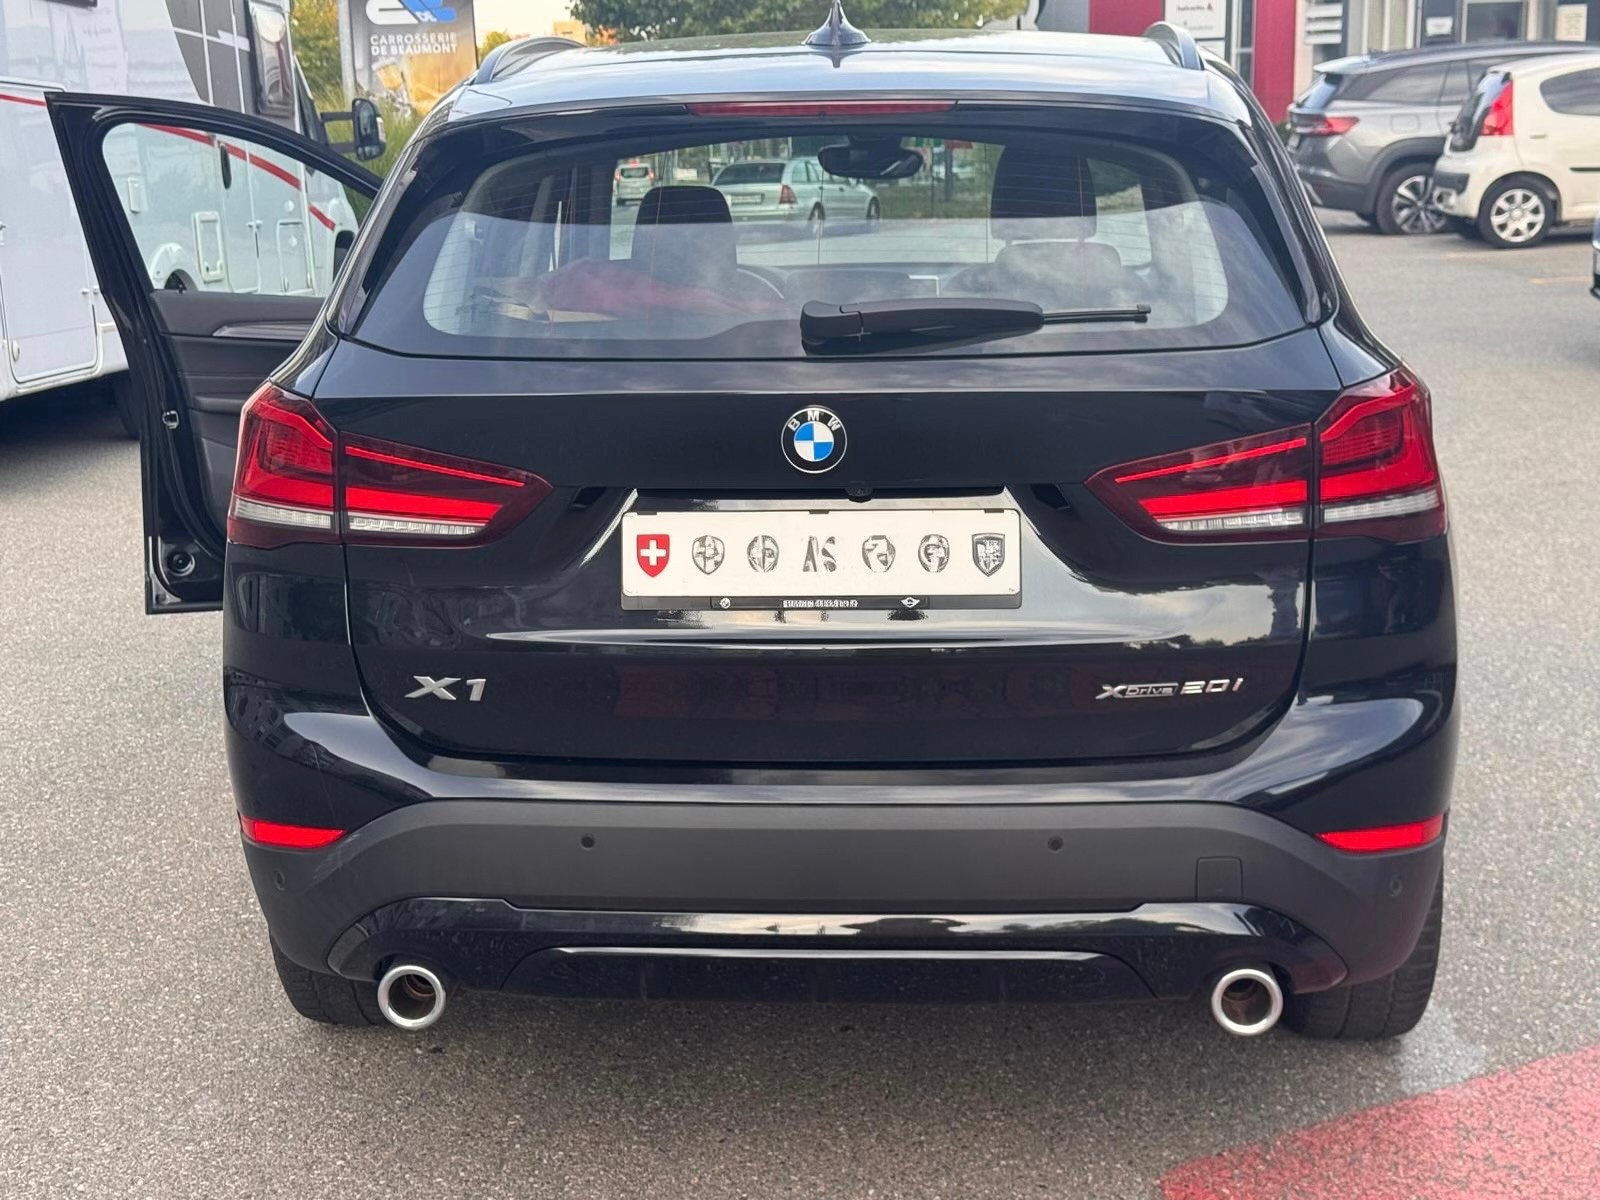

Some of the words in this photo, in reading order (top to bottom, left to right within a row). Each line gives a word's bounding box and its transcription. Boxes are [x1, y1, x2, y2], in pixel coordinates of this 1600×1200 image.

[370, 32, 457, 45] CARROSSERIE
[371, 46, 387, 56] DE
[391, 44, 457, 55] BEAUMONT
[787, 410, 841, 431] BMW
[404, 675, 487, 702] X1
